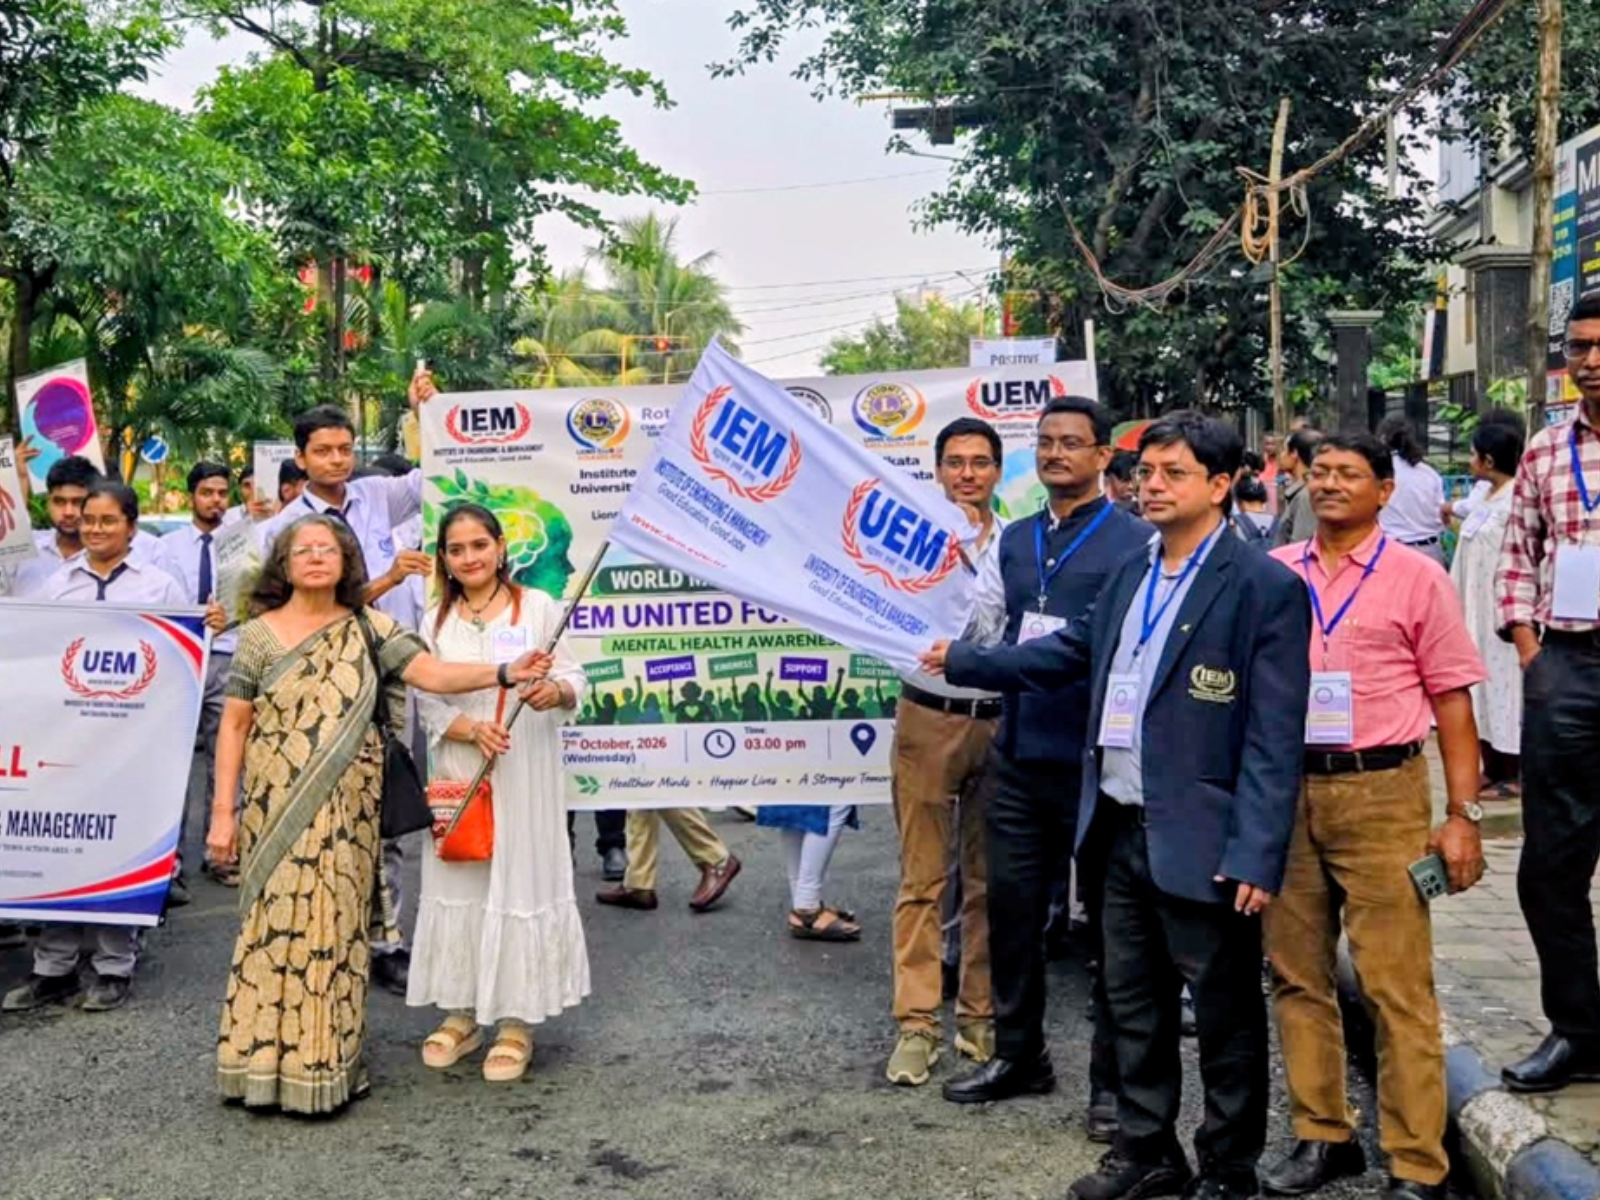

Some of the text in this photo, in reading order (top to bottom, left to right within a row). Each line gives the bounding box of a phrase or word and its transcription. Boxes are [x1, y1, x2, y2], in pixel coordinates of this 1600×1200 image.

[981, 380, 1050, 406] UEM
[461, 406, 516, 433] IEM
[641, 407, 670, 420] Rot
[709, 398, 787, 477] IEM
[579, 468, 637, 480] Institute
[570, 482, 632, 495] Universit
[860, 489, 949, 573] UEM
[610, 570, 684, 590] WORLD
[622, 602, 733, 627] UNITED
[612, 638, 677, 652] MENTAL
[680, 636, 743, 650] HEALTH
[83, 650, 137, 674] UEM
[785, 663, 822, 675] SUPPORT
[1201, 669, 1230, 685] IEM
[580, 738, 635, 751] October,
[637, 737, 667, 749] 2026
[744, 738, 806, 751] 03.00 pm
[562, 752, 636, 765] (Wednesday)
[799, 773, 809, 785] A
[6, 810, 117, 840] MANAGEMENT
